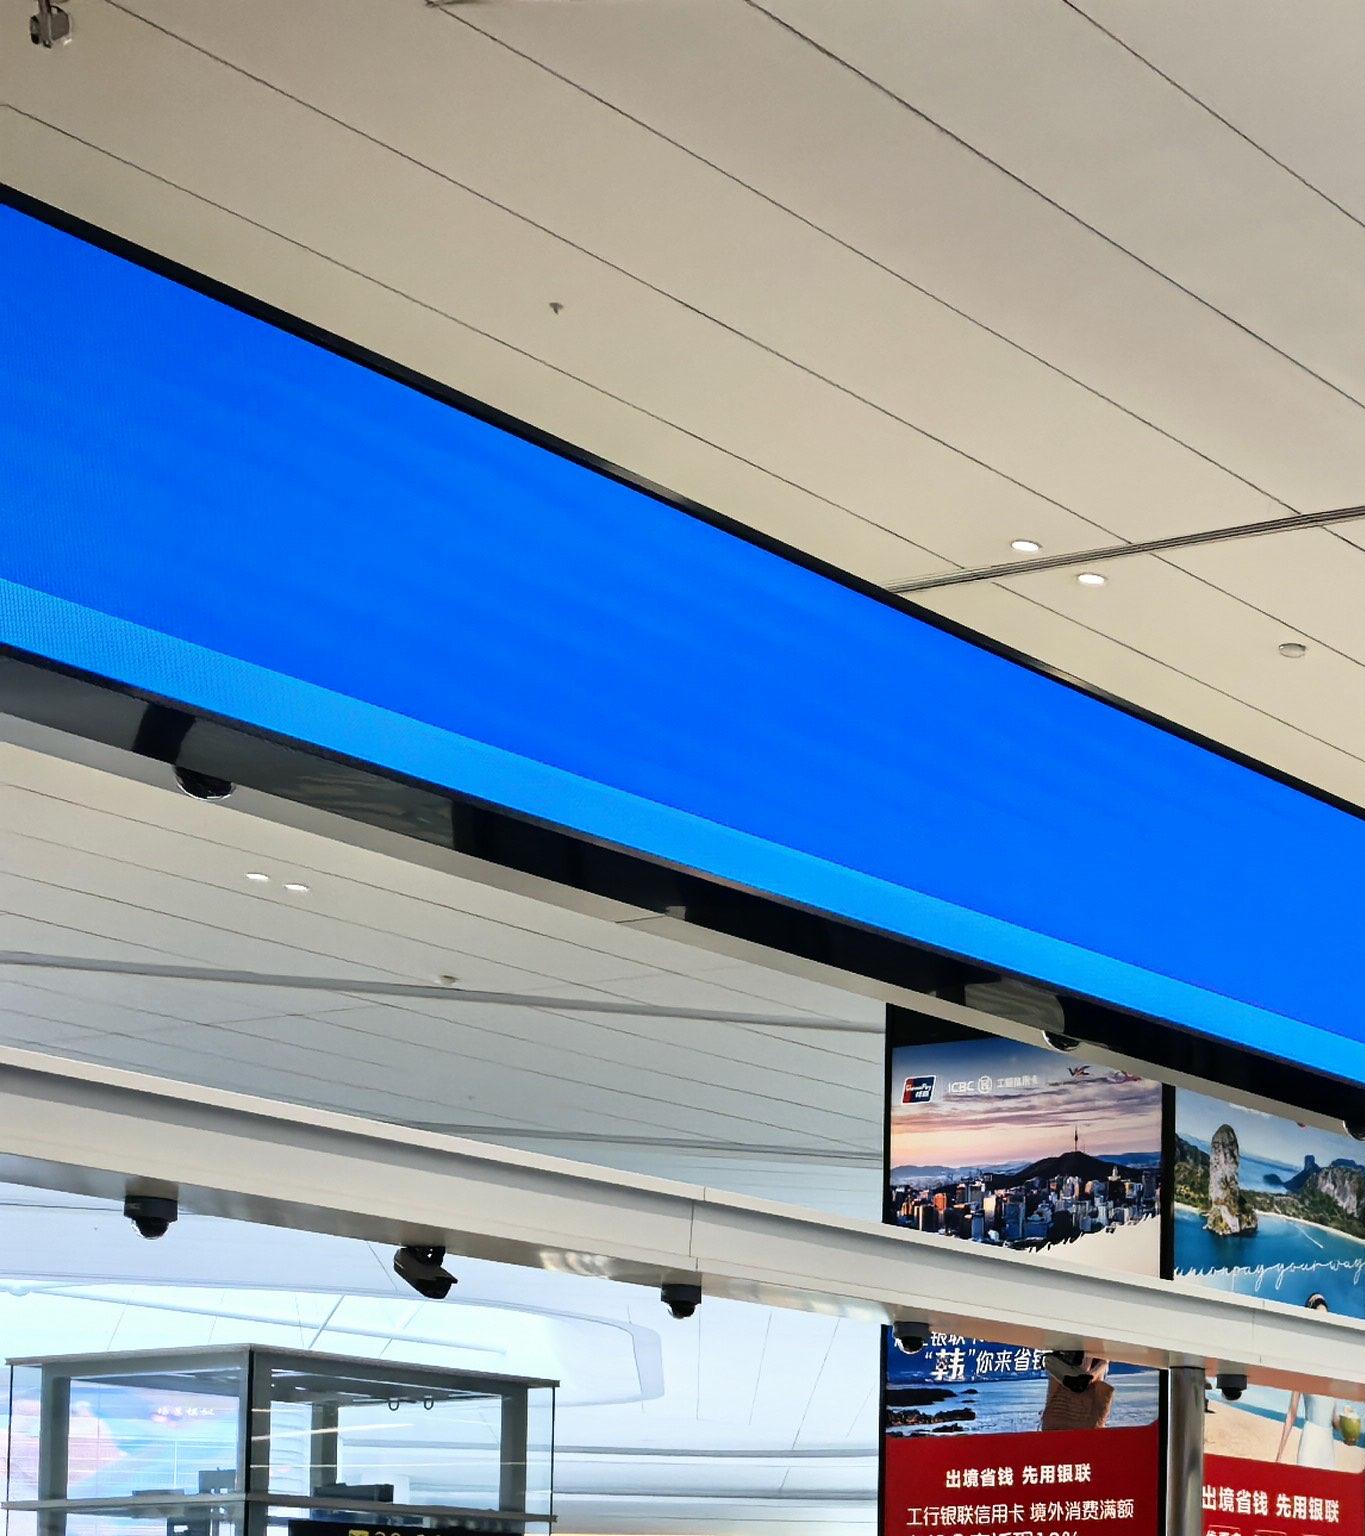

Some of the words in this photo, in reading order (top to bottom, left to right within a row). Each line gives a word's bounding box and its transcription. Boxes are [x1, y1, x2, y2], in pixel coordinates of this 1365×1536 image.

[946, 1467, 1014, 1488] 出境省钱
[1022, 1463, 1091, 1485] 先用银联
[907, 1504, 1024, 1526] 工行银联信用卡
[1030, 1499, 1134, 1522] 境外消费满额
[1202, 1485, 1268, 1516] 出境省钱
[1276, 1493, 1340, 1523] 先用银联
